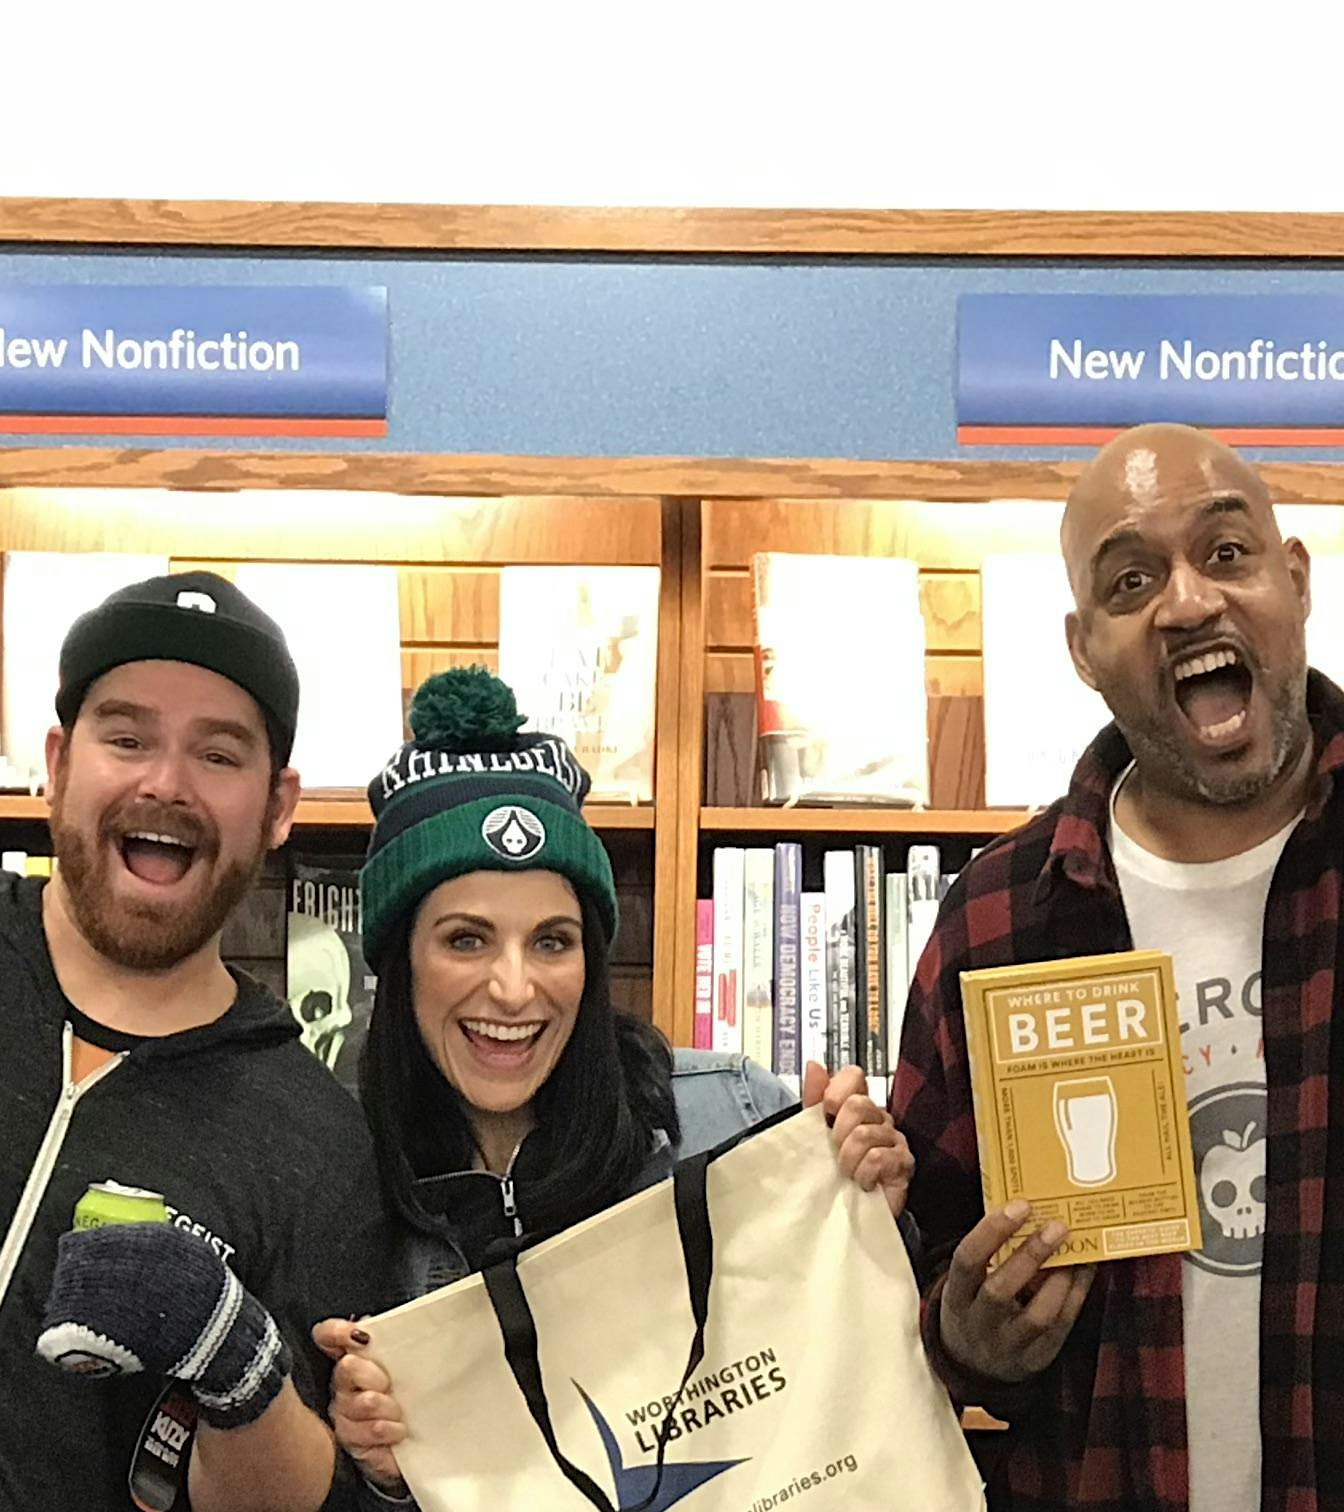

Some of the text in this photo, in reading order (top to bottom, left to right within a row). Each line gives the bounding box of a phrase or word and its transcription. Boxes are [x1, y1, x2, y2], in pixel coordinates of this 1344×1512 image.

[81, 329, 299, 373] Nonfiction
[1049, 340, 1144, 382] New
[779, 904, 796, 938] HOW
[779, 944, 796, 1034] DEMOCRACY
[806, 904, 821, 1029] People Like Us
[1007, 981, 1140, 1009] WHERE TO DRINK
[1008, 999, 1148, 1053] BEER
[1006, 1048, 1155, 1074] FOAM IS WHERE THE HEART IS
[625, 1347, 777, 1428] WORTHINGTON
[635, 1366, 787, 1454] LIBRARIES
